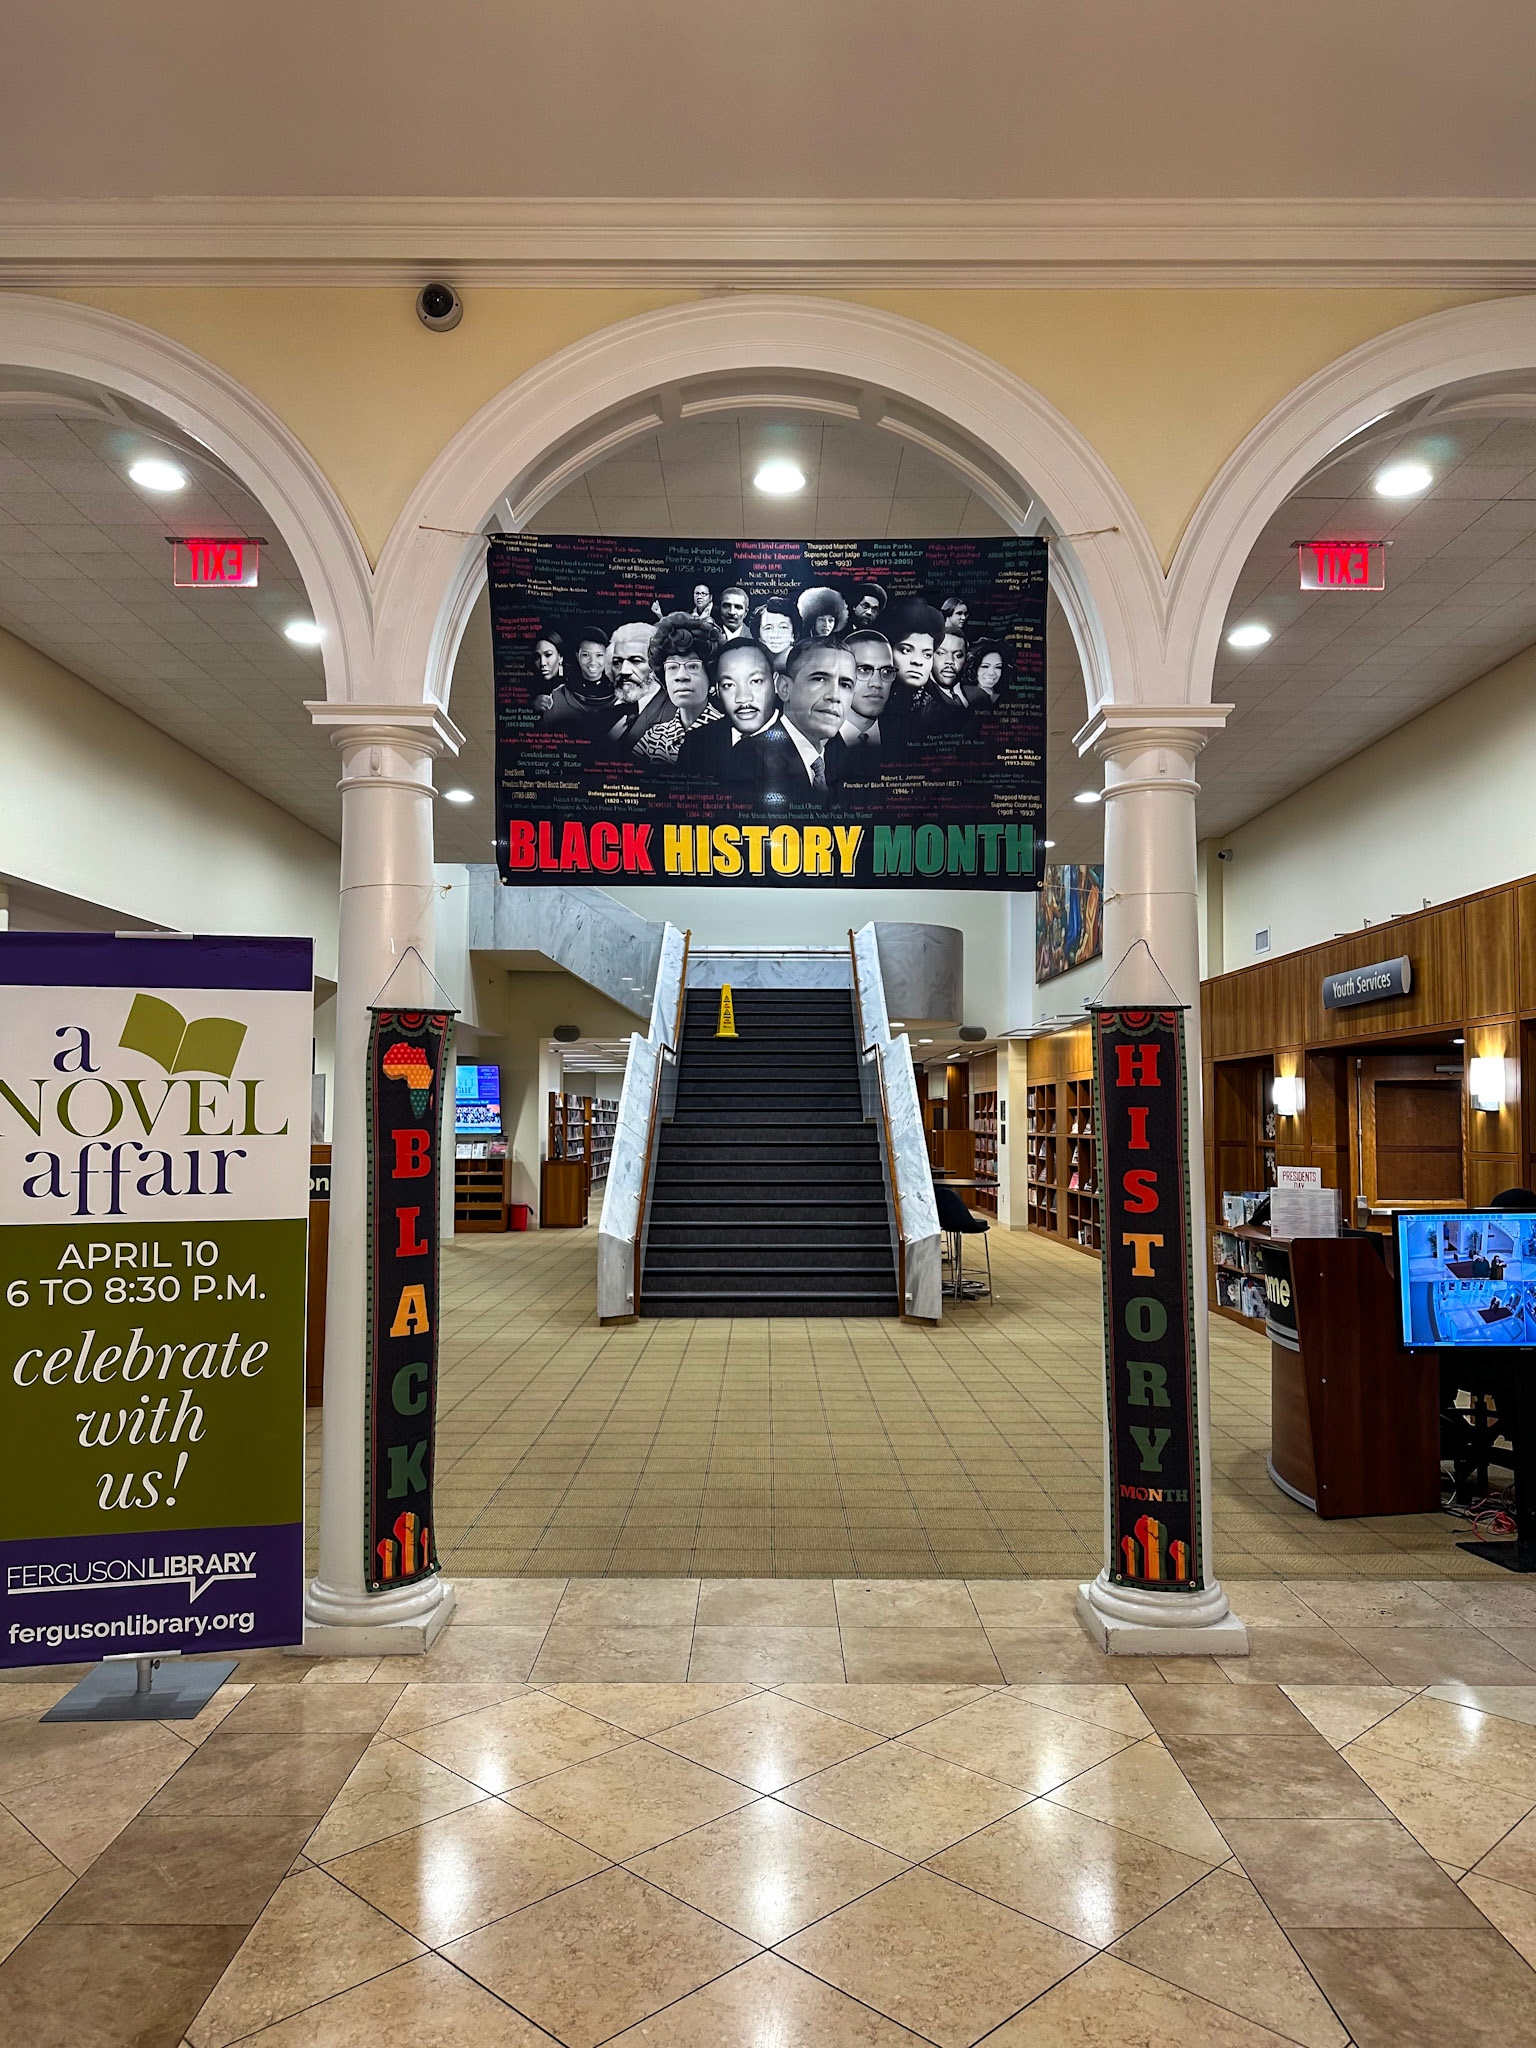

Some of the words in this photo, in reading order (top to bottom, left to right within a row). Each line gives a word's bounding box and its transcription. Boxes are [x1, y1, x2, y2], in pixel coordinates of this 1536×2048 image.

[666, 556, 692, 564] Poetry
[695, 556, 731, 564] Published
[807, 543, 833, 551] Thurgood
[509, 820, 656, 875] BLACK
[664, 824, 864, 877] HISTORY
[872, 824, 1036, 877] MONTH
[1332, 977, 1355, 999] Youth
[1356, 971, 1391, 994] Services
[53, 1026, 101, 1073] a
[22, 1141, 247, 1216] affair
[1282, 1170, 1317, 1182] PRESIDENTS
[57, 1242, 173, 1271] APRIL
[181, 1240, 219, 1267] 10
[6, 1279, 30, 1308] 6
[39, 1278, 94, 1306] TO
[104, 1275, 181, 1304] 8:30
[193, 1273, 266, 1301] P.M.
[12, 1327, 270, 1387] celebrate
[76, 1388, 207, 1448] with
[96, 1451, 189, 1511] us!
[1120, 1484, 1189, 1502] MONTH
[8, 1611, 255, 1647] fergusonlibrary.org
